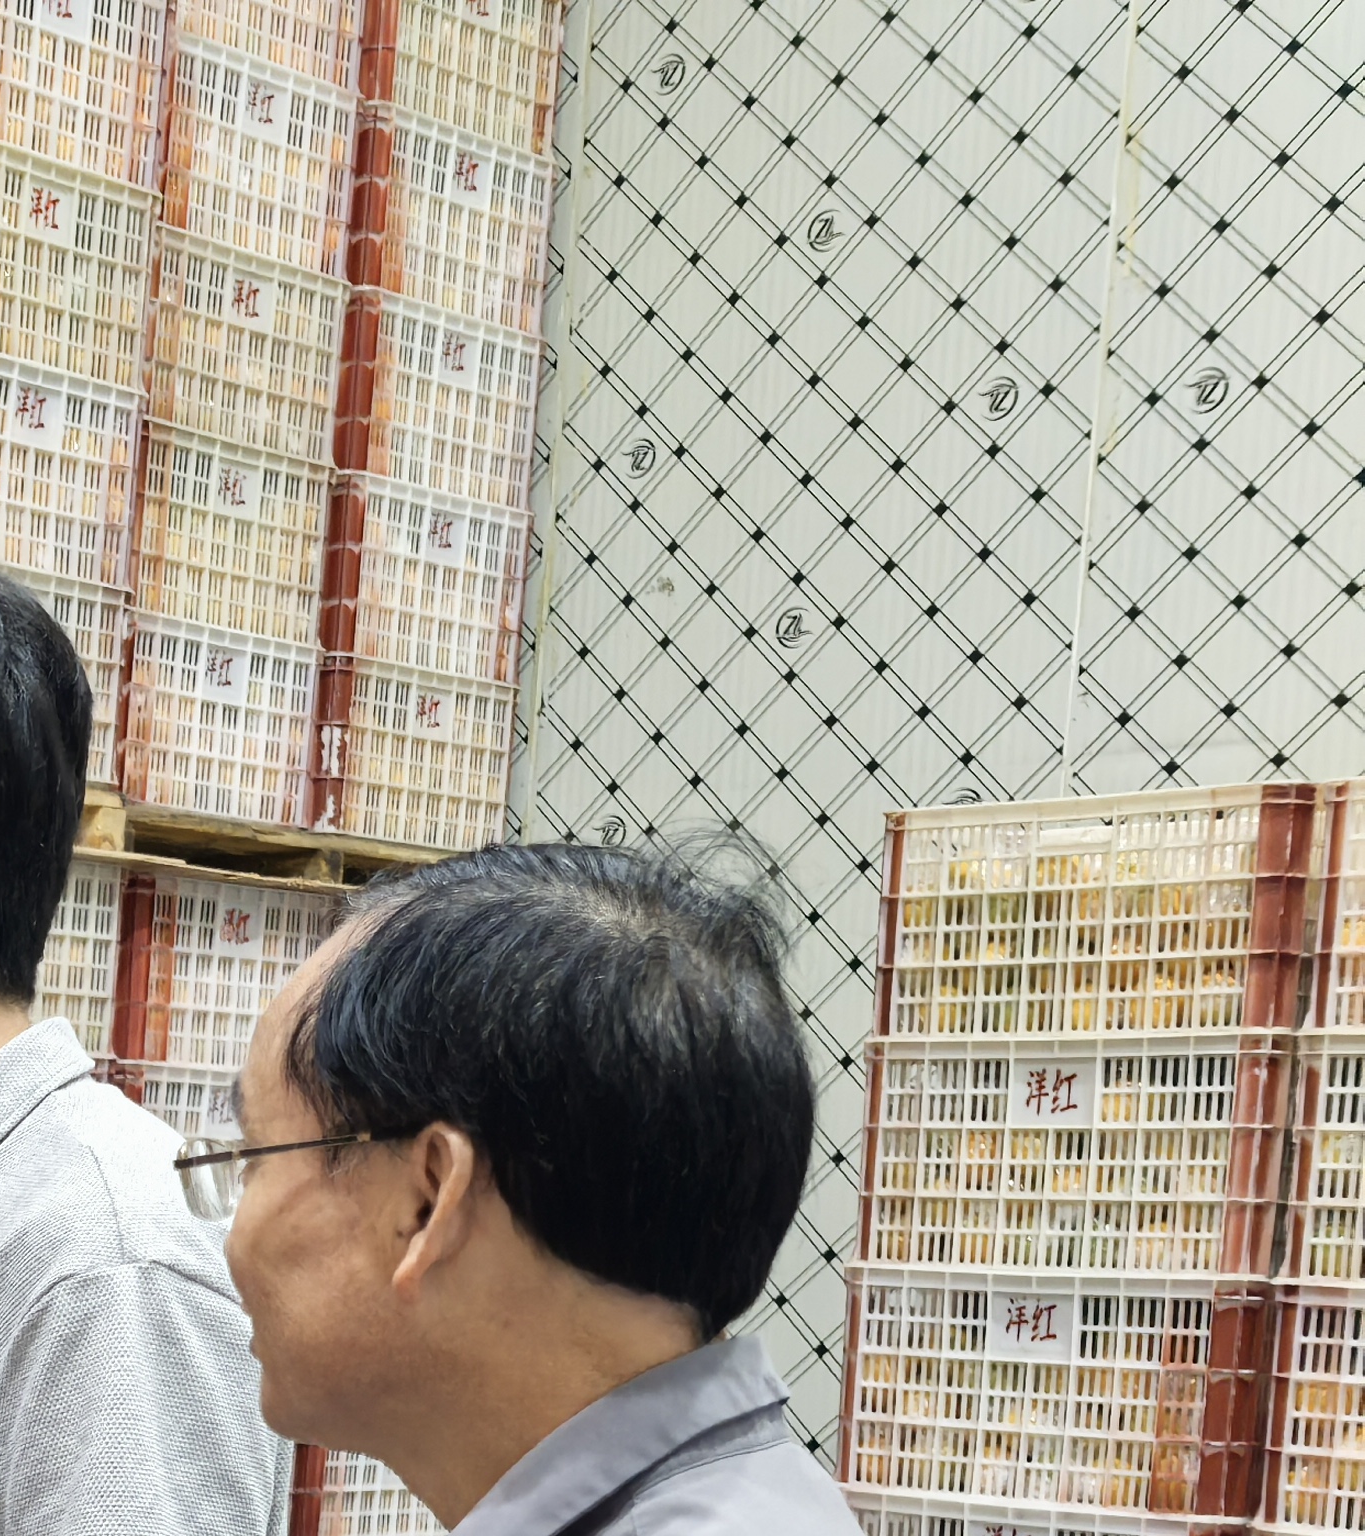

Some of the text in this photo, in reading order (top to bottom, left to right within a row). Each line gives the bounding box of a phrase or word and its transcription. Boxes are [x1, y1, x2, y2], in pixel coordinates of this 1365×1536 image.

[247, 82, 275, 124] 洋红
[455, 152, 479, 191] 洋红
[29, 187, 60, 231] 洋红
[233, 279, 260, 318] 洋红
[15, 387, 46, 430] 洋红
[219, 467, 246, 506] 洋红
[207, 648, 233, 687] 洋红
[1026, 1068, 1079, 1115] 洋红
[1005, 1298, 1057, 1343] 洋红
